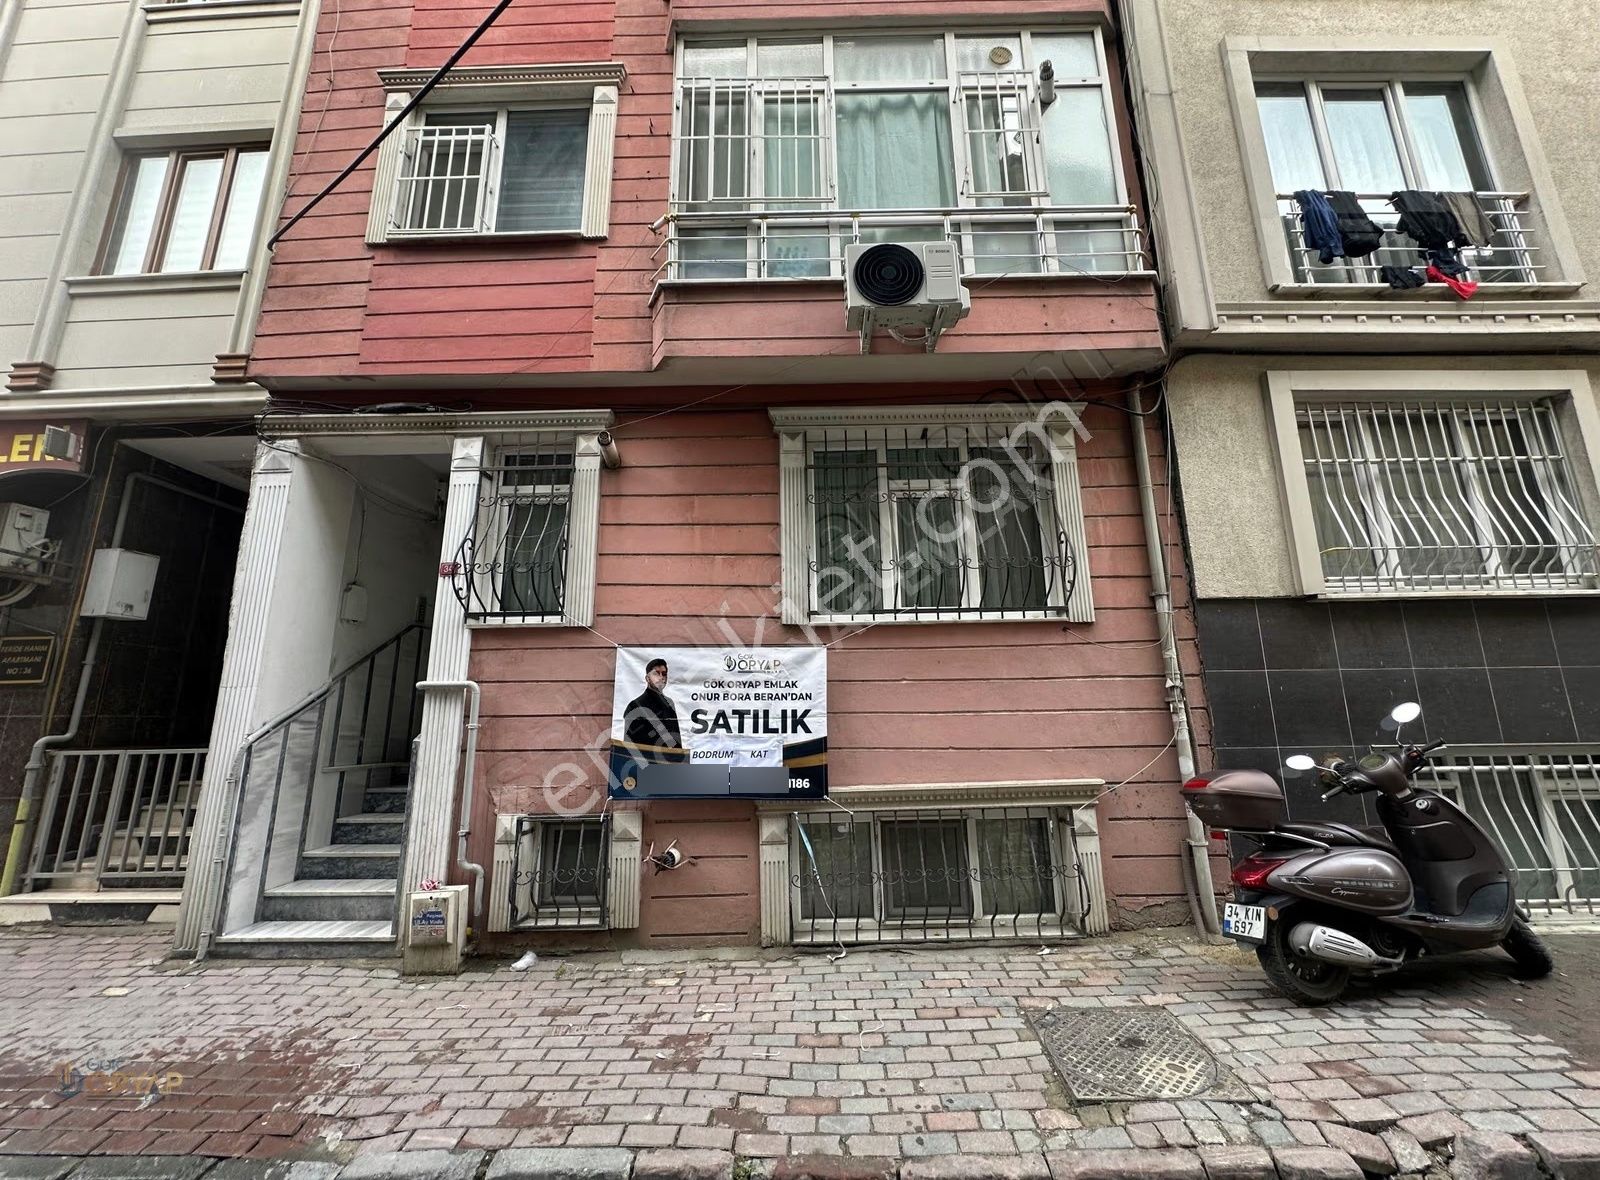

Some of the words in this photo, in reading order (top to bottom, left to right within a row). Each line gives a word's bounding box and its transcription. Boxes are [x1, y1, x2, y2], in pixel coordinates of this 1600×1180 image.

[727, 680, 761, 689] ORYAP
[763, 680, 798, 689] EMLAK
[691, 692, 720, 701] ONUR
[722, 692, 752, 701] BORA
[690, 708, 813, 734] SATILIK
[692, 750, 734, 759] BODRUM
[750, 750, 769, 759] KAT
[1227, 905, 1239, 919] 34
[1244, 906, 1262, 922] KIN
[1233, 920, 1254, 935] 697
